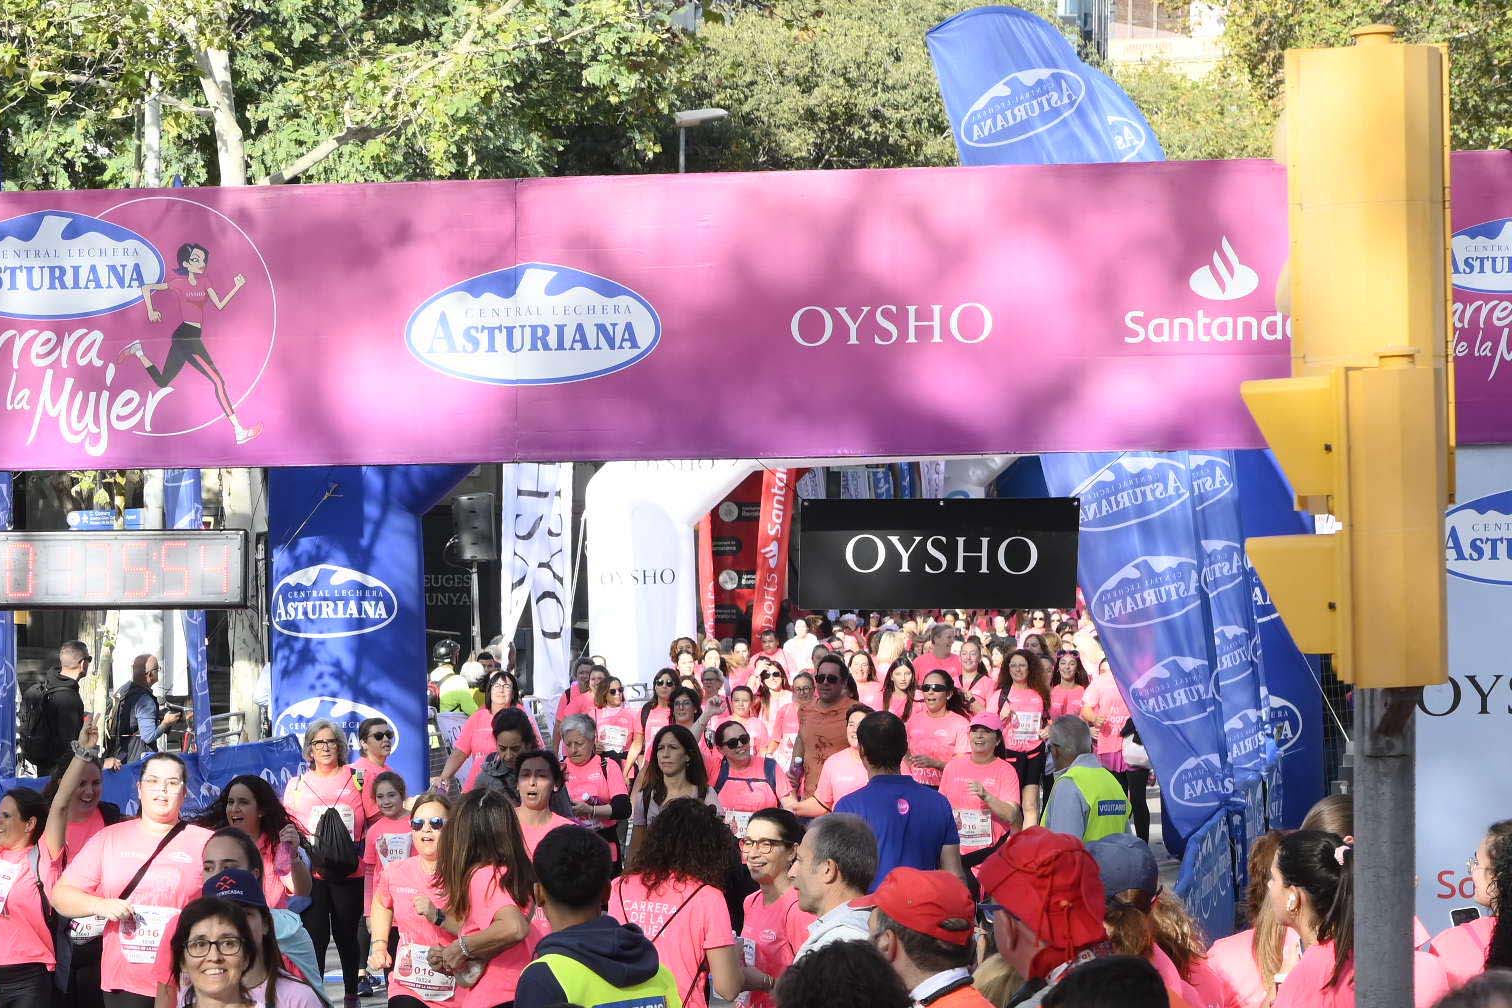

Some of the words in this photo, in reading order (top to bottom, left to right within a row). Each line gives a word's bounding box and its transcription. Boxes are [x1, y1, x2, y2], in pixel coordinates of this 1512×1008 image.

[67, 246, 140, 259] LECHERA
[465, 305, 543, 318] CENTRAL
[552, 304, 633, 316] LECHERA
[427, 309, 642, 354] ASTURIANA
[790, 303, 993, 347] OYSHO
[1124, 309, 1293, 343] Santand
[6, 372, 31, 411] la
[26, 364, 175, 457] Mujer
[844, 534, 1039, 575] OYSHO
[288, 589, 330, 599] CENTRAL
[335, 589, 384, 598] LECHERA
[275, 594, 389, 622] ASTURIANA
[623, 900, 679, 915] CARRERA
[631, 912, 647, 924] DE
[649, 913, 665, 924] LA
[414, 966, 435, 977] 016
